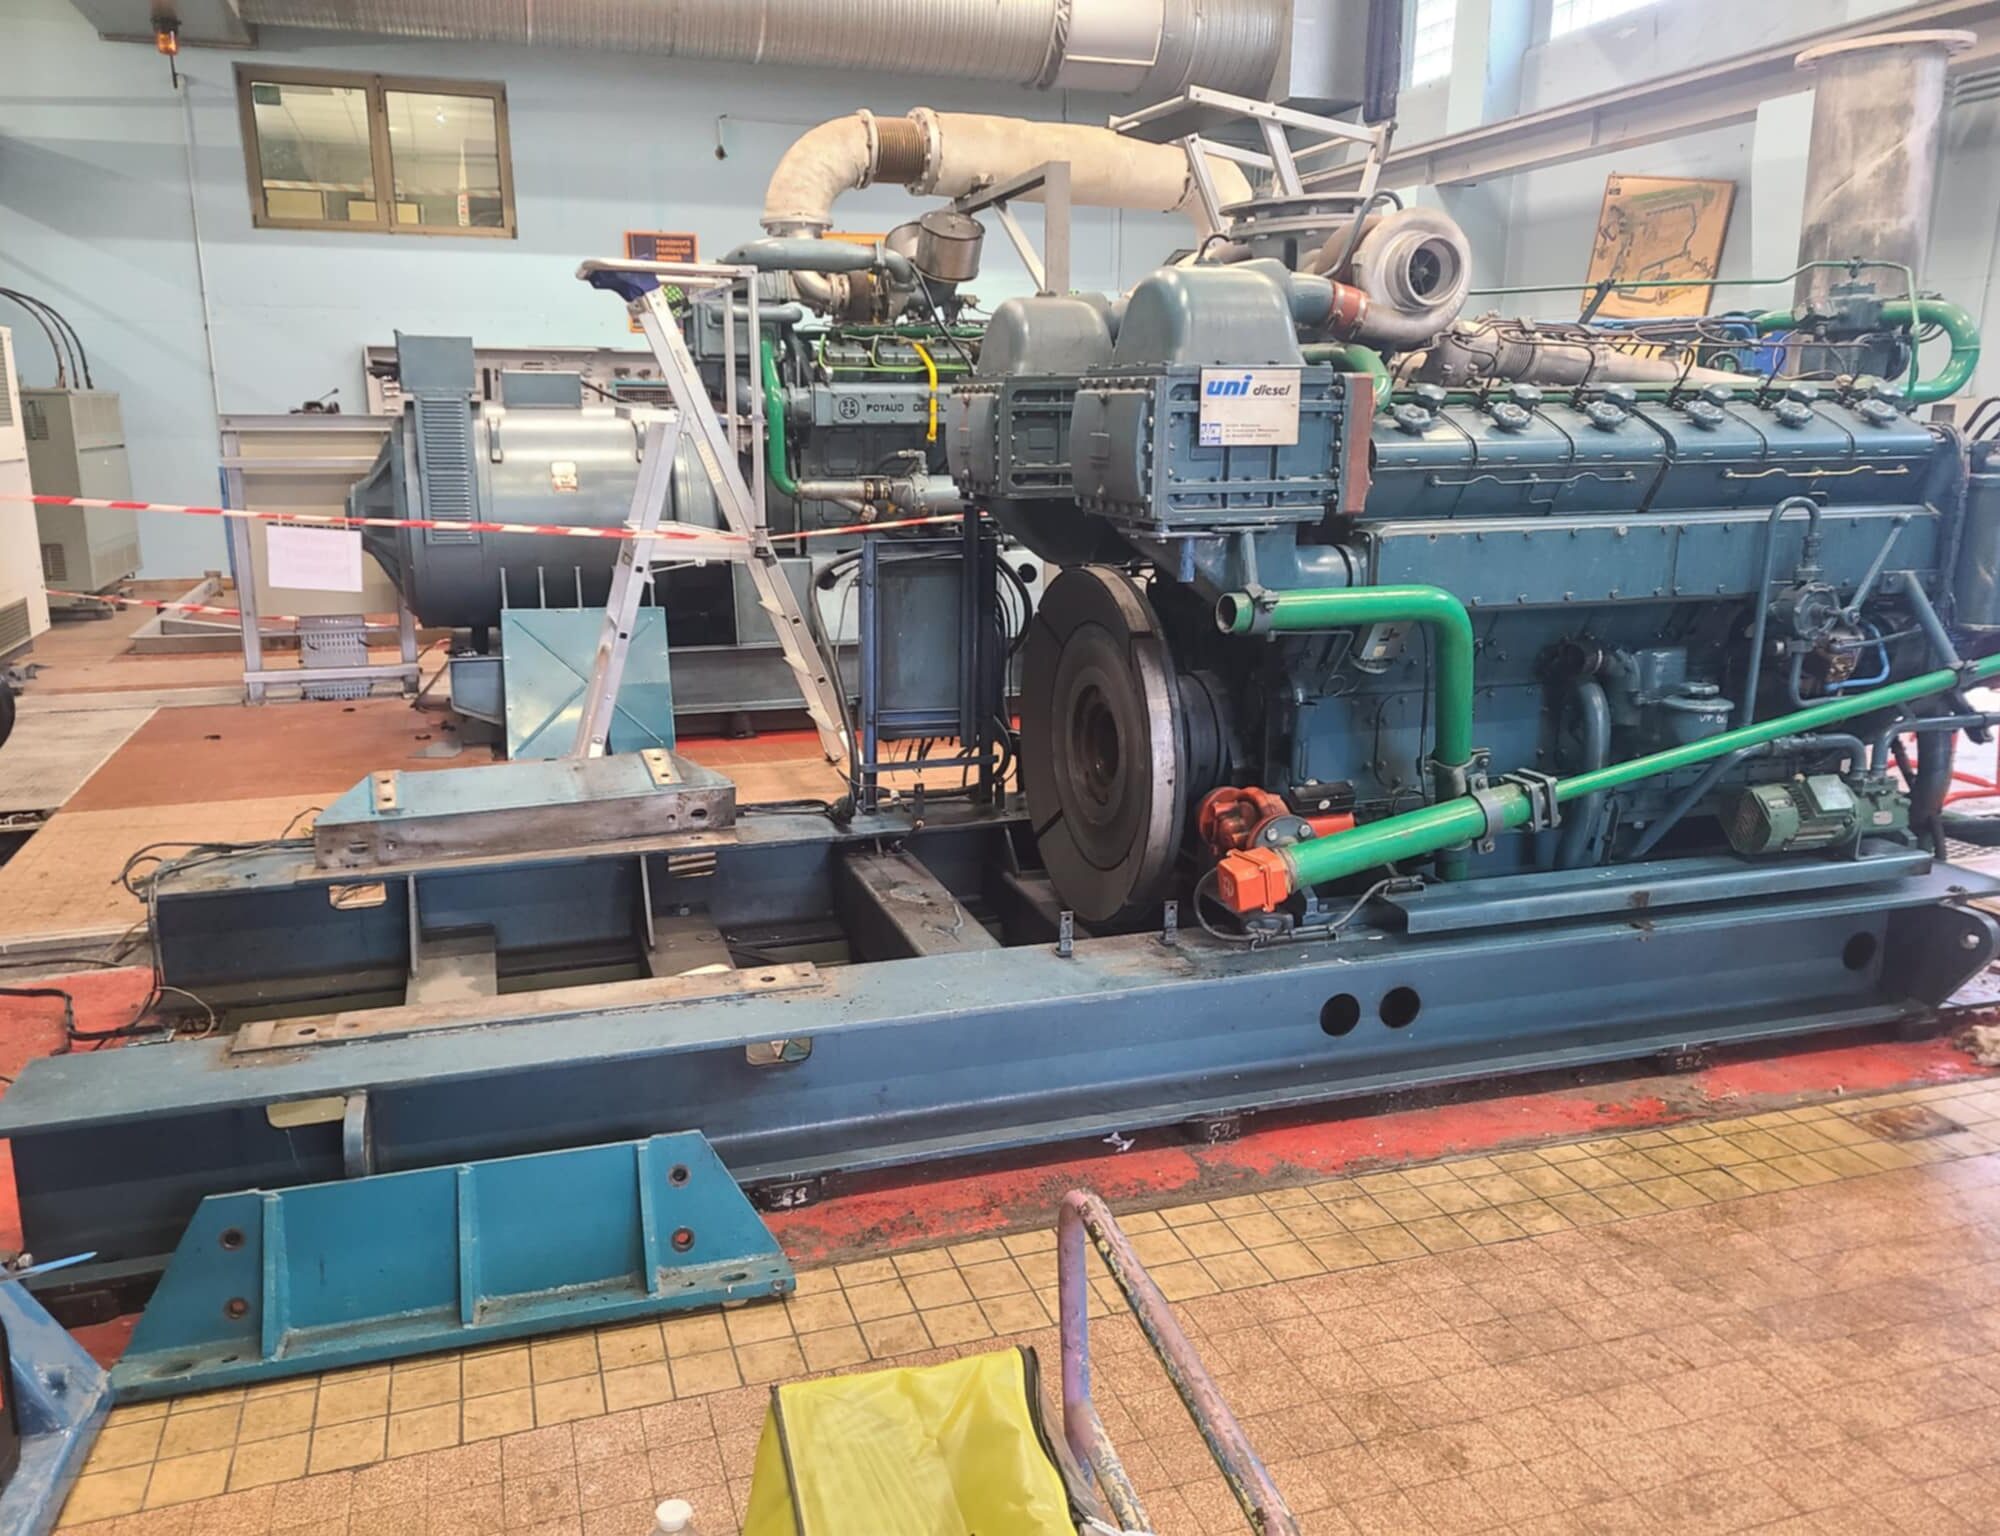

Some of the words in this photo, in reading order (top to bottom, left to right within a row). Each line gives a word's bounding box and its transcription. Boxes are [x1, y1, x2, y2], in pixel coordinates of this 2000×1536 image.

[1206, 374, 1253, 396] uni
[1253, 384, 1292, 396] diesel
[866, 403, 904, 412] POYAUD
